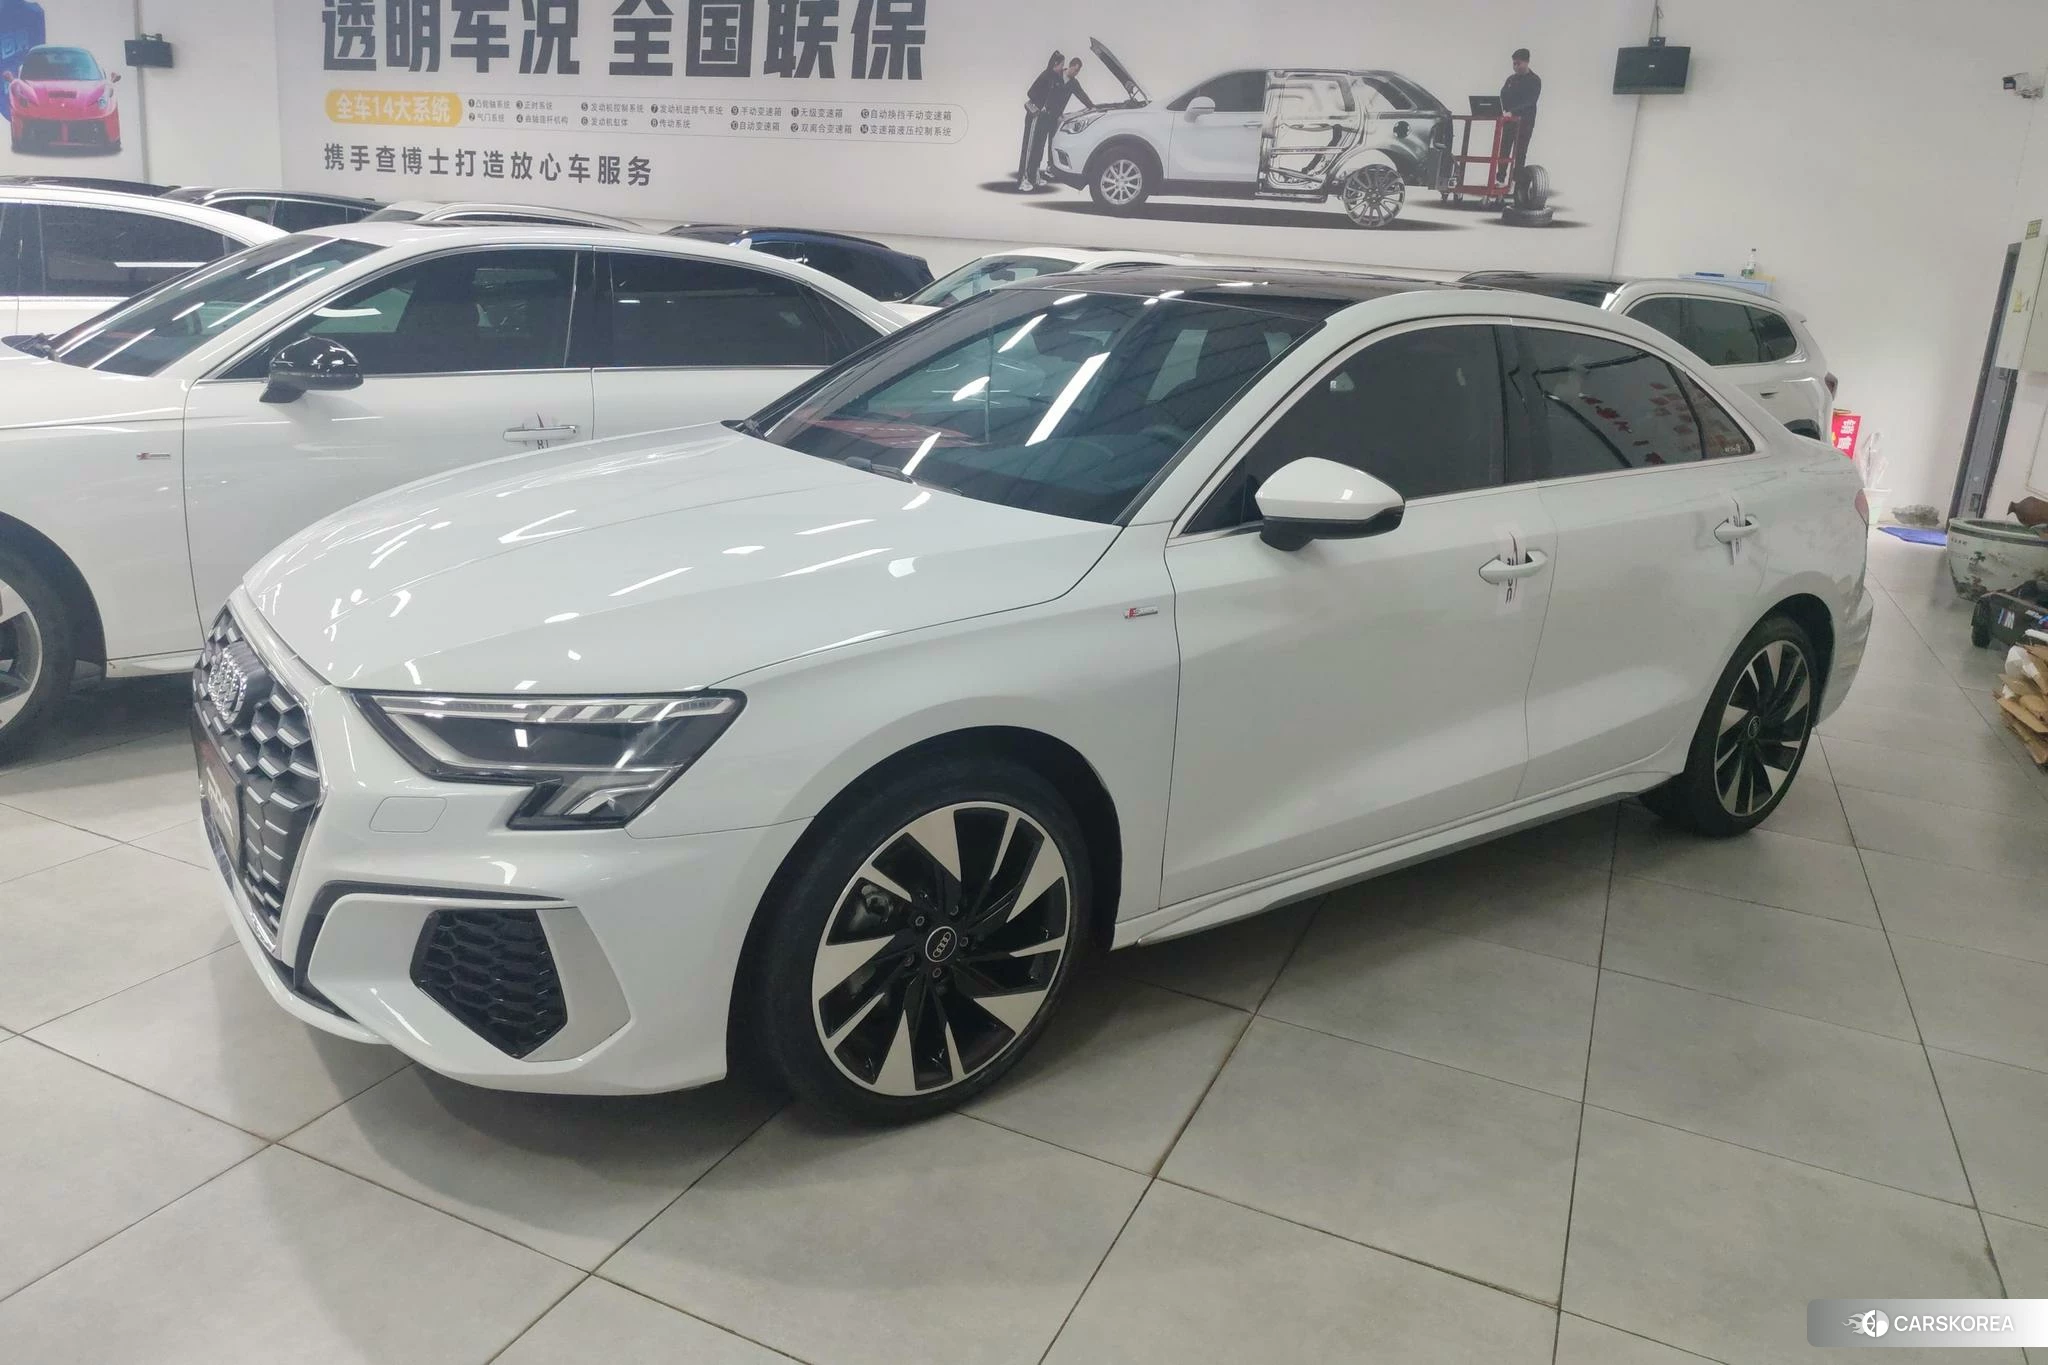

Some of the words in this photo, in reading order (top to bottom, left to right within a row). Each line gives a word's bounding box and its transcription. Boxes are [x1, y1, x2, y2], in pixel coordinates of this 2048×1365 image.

[322, 0, 580, 75] 透明车况
[609, 0, 926, 80] 全国联保
[335, 93, 450, 122] 全车14大系统
[324, 143, 652, 187] 携手查博士打造放心车服务
